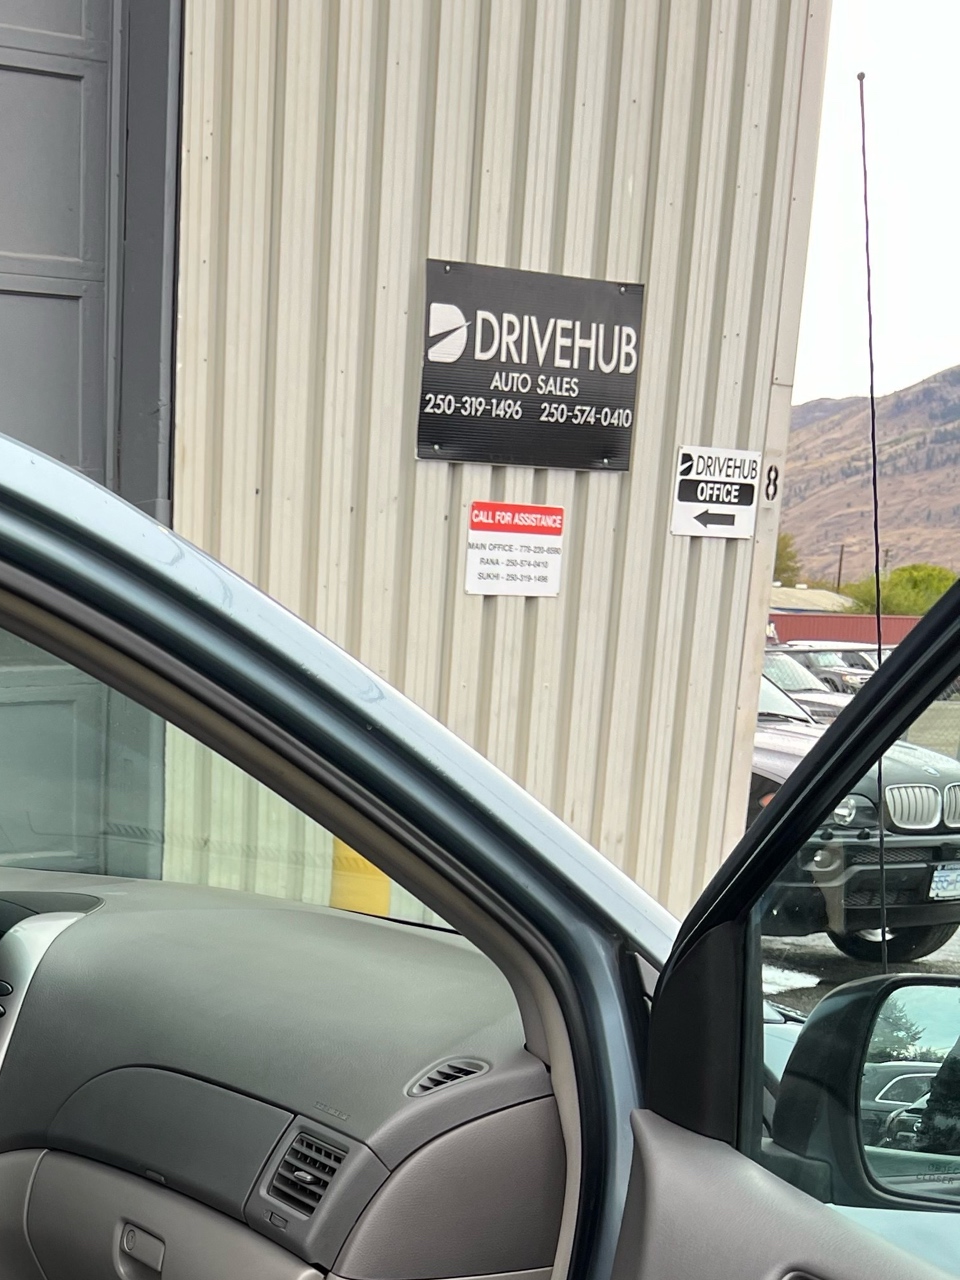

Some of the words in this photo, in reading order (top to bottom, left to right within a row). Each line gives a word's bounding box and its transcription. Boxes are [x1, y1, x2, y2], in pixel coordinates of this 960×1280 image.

[474, 310, 638, 374] DRIVEHUB
[490, 371, 532, 393] AUTO
[536, 375, 579, 397] SALES
[424, 393, 522, 420] 250-319-1496
[539, 402, 632, 427] 250-574-0410
[695, 455, 758, 480] DRIVEHUB
[697, 482, 740, 503] OFFICE
[765, 464, 779, 501] 8
[471, 509, 493, 523] CALL
[495, 511, 513, 525] FOR
[513, 512, 562, 528] ASSISTANCE
[467, 542, 487, 551] MAIN
[488, 543, 514, 552] OFFICE
[479, 557, 500, 566] RANA
[916, 1173, 955, 1185] CLOSER
